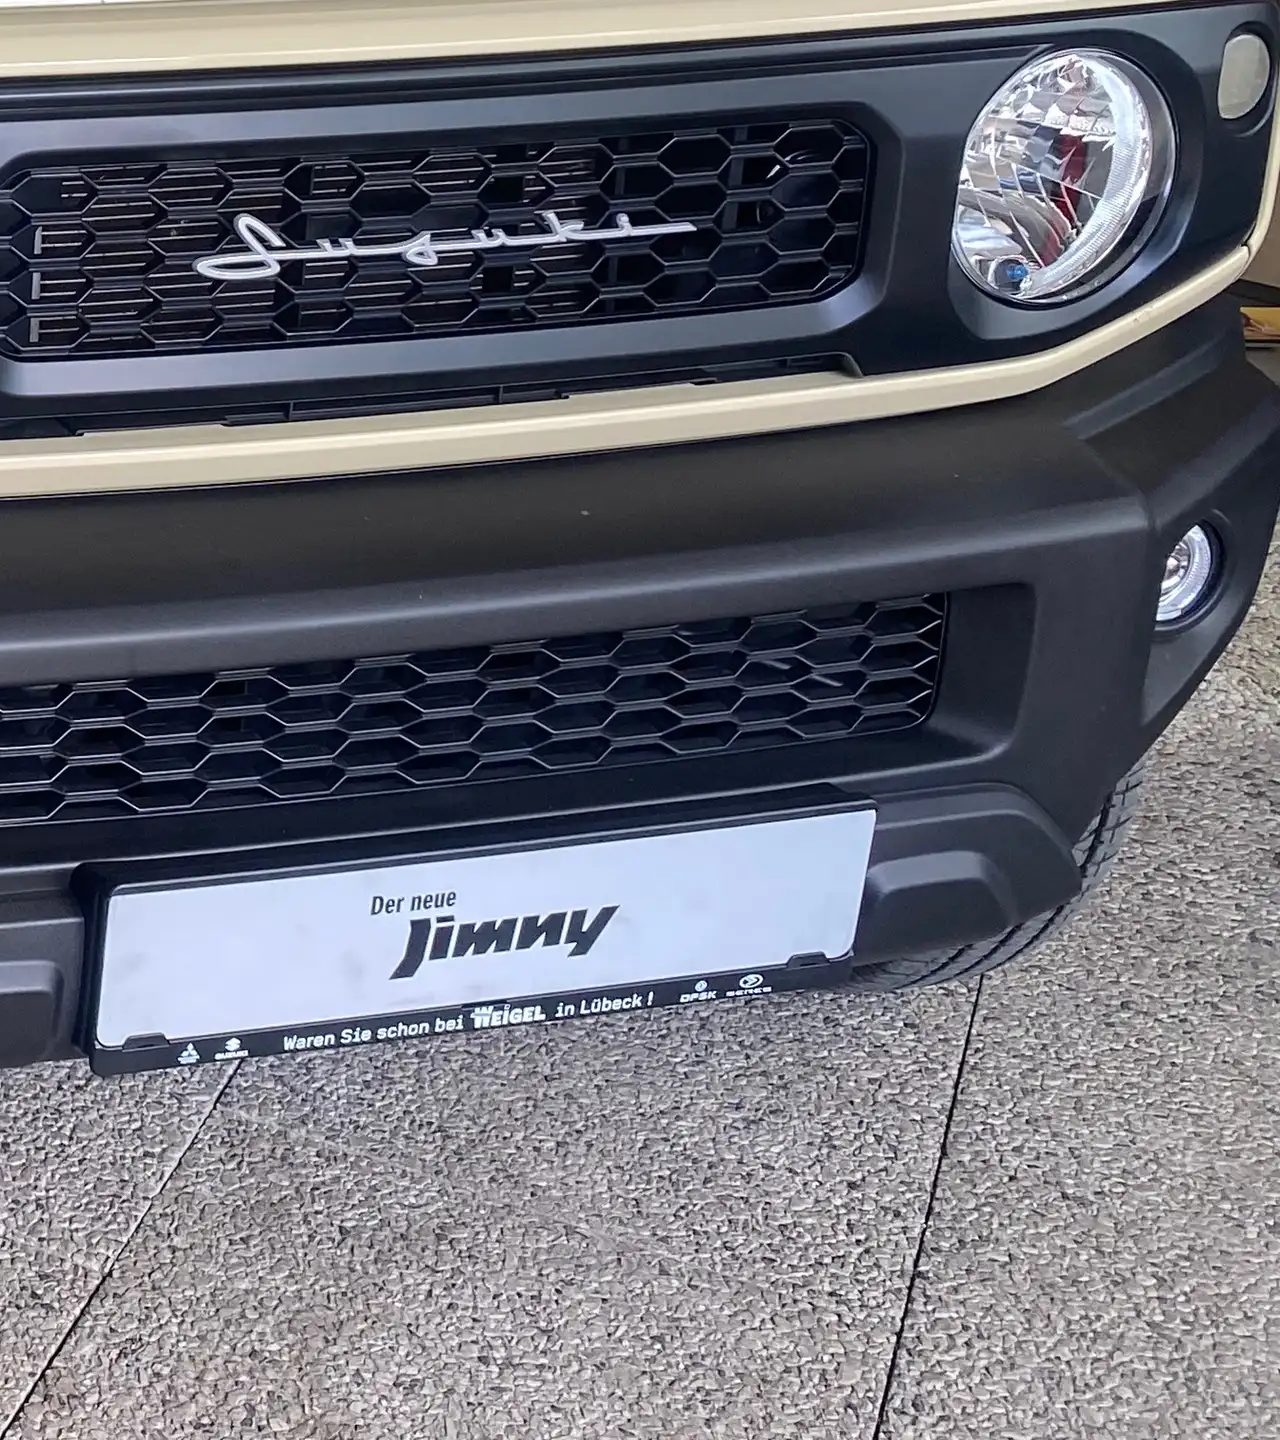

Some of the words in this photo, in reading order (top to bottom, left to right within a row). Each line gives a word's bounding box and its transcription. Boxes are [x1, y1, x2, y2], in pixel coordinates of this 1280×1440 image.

[193, 212, 697, 280] Suzuki
[370, 895, 404, 915] Der
[410, 891, 456, 912] neue
[388, 904, 620, 980] Jimny
[283, 1032, 335, 1050] Waren
[340, 1028, 371, 1045] Sie
[377, 1021, 429, 1040] schon
[435, 1014, 463, 1033] bei
[555, 1002, 574, 1018] in
[580, 993, 642, 1015] Lübeck
